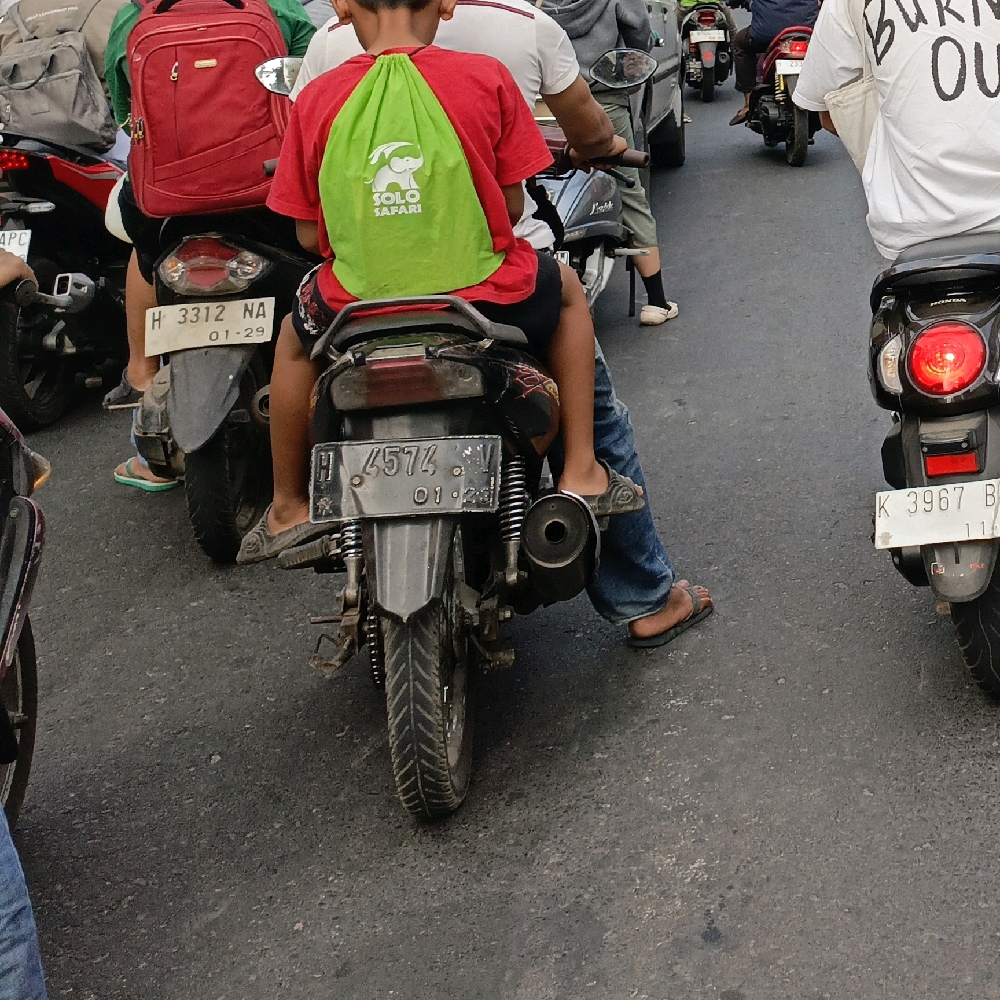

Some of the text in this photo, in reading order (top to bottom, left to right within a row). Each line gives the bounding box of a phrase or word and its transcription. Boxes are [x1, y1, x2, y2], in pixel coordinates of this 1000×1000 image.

[373, 189, 421, 206] SOLO
[374, 203, 423, 217] SAFARI
[151, 301, 267, 330] H 3312 NA
[317, 452, 334, 482] H
[362, 444, 438, 477] 4574
[878, 494, 890, 518] K
[906, 486, 965, 514] 3967
